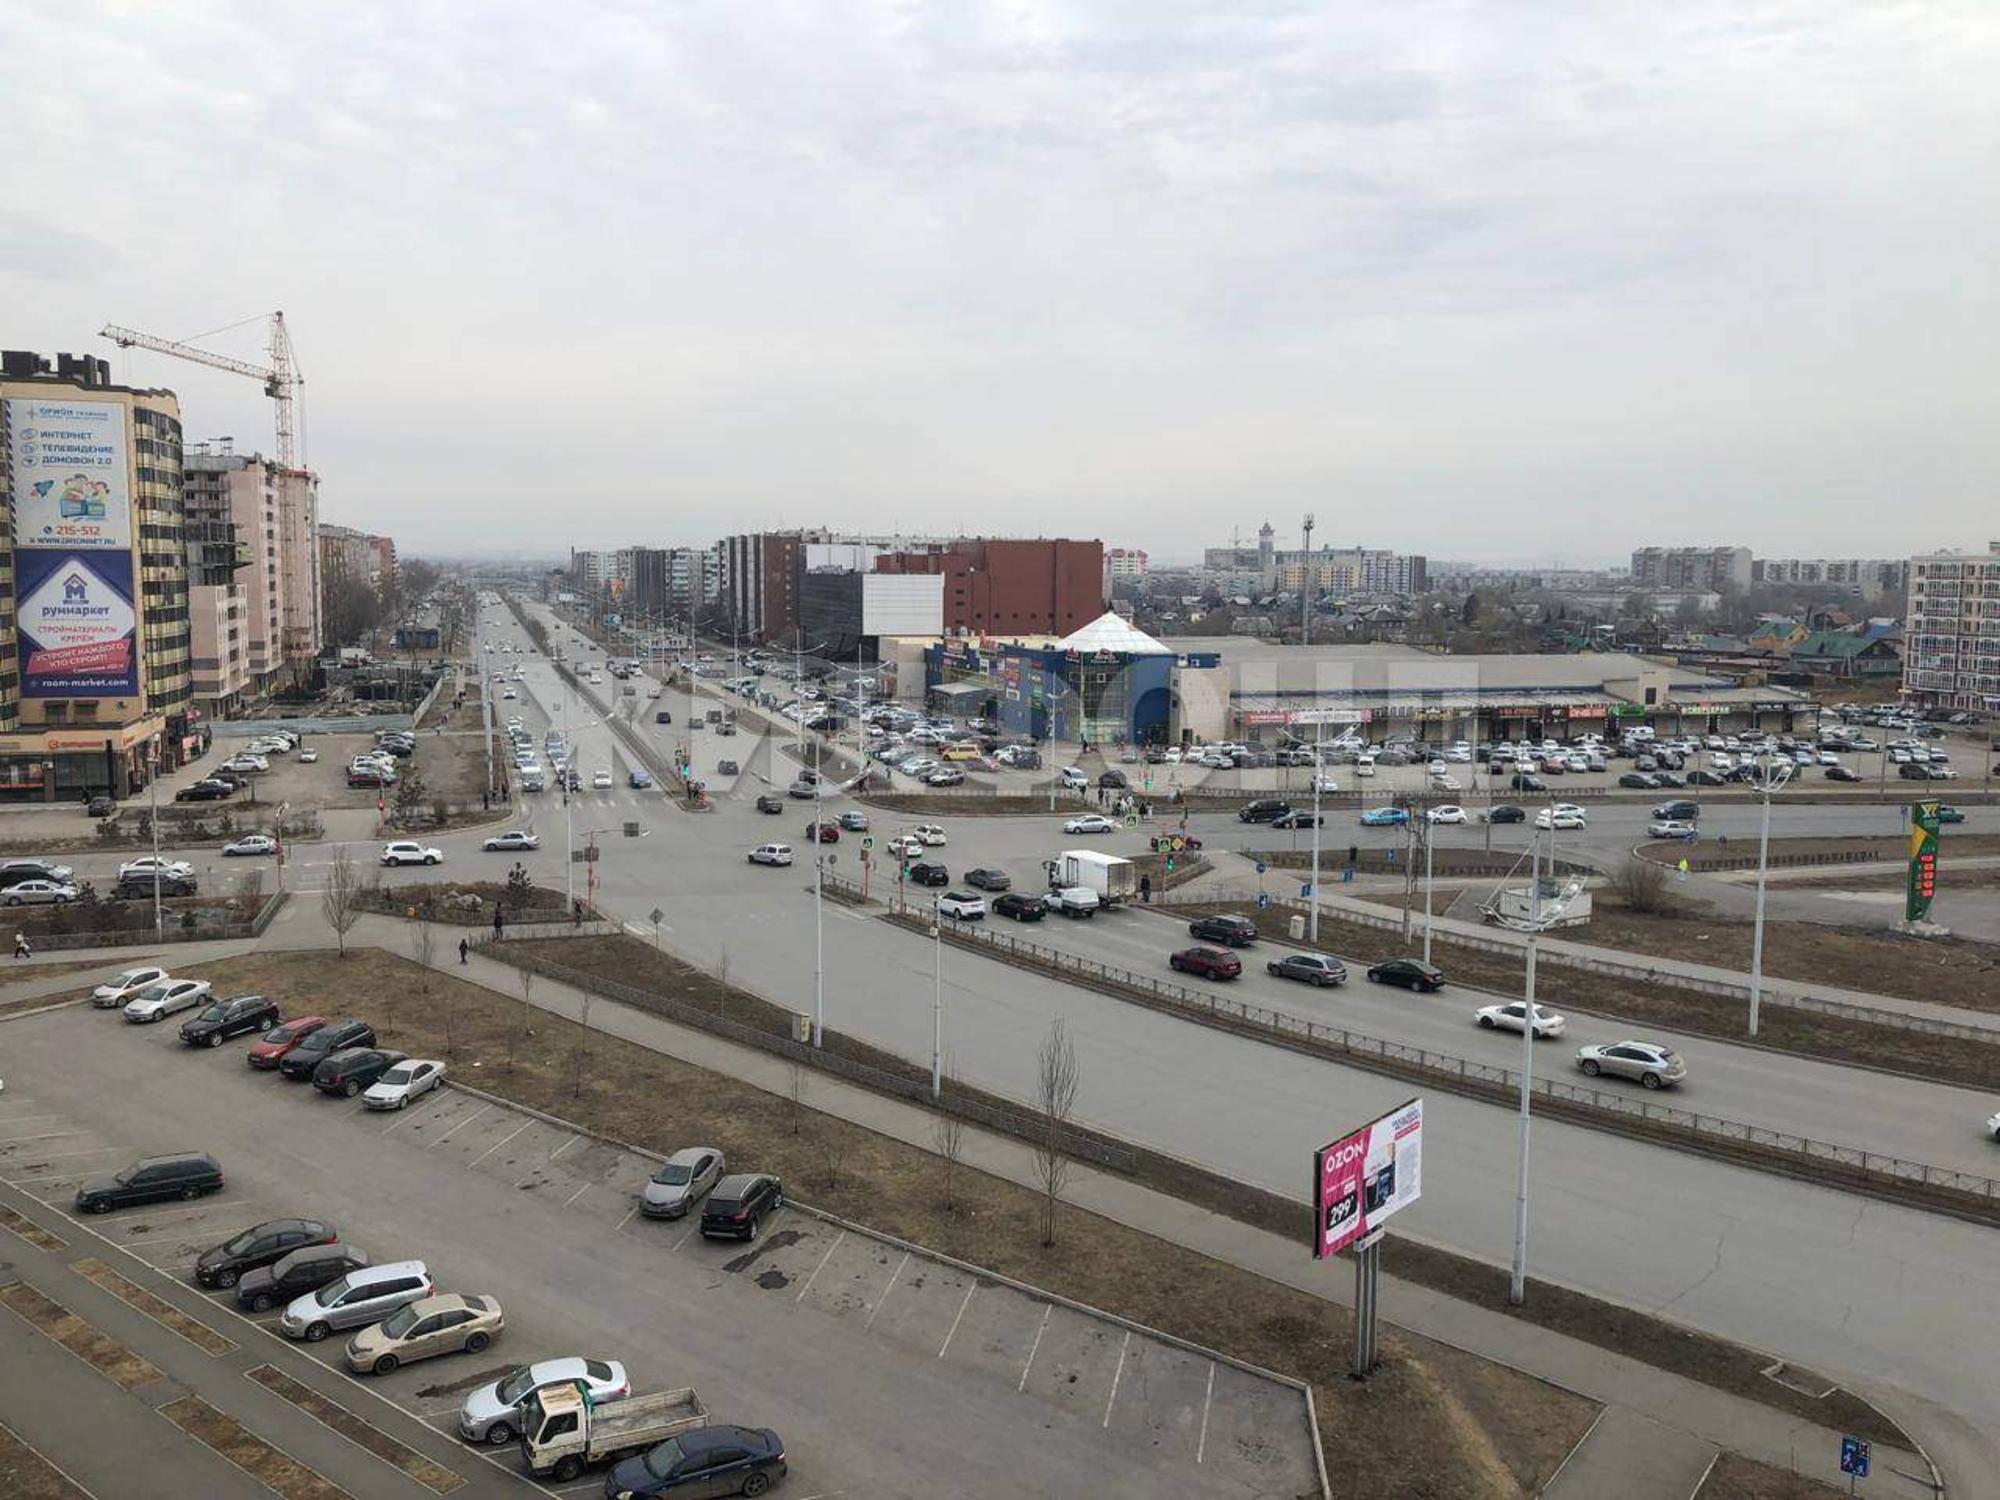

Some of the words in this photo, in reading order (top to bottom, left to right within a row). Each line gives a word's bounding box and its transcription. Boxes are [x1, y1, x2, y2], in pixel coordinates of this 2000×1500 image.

[40, 431, 92, 440] ИНТЕРНЕТ
[42, 444, 113, 453] ТЕЛЕВИДЕНИЕ
[42, 456, 95, 465] ДОМОФОН
[98, 457, 112, 465] 2.0
[56, 526, 101, 536] 215-512
[42, 606, 110, 617] руммаркет
[42, 679, 129, 687] room-market.com
[1326, 1139, 1364, 1173] OZON
